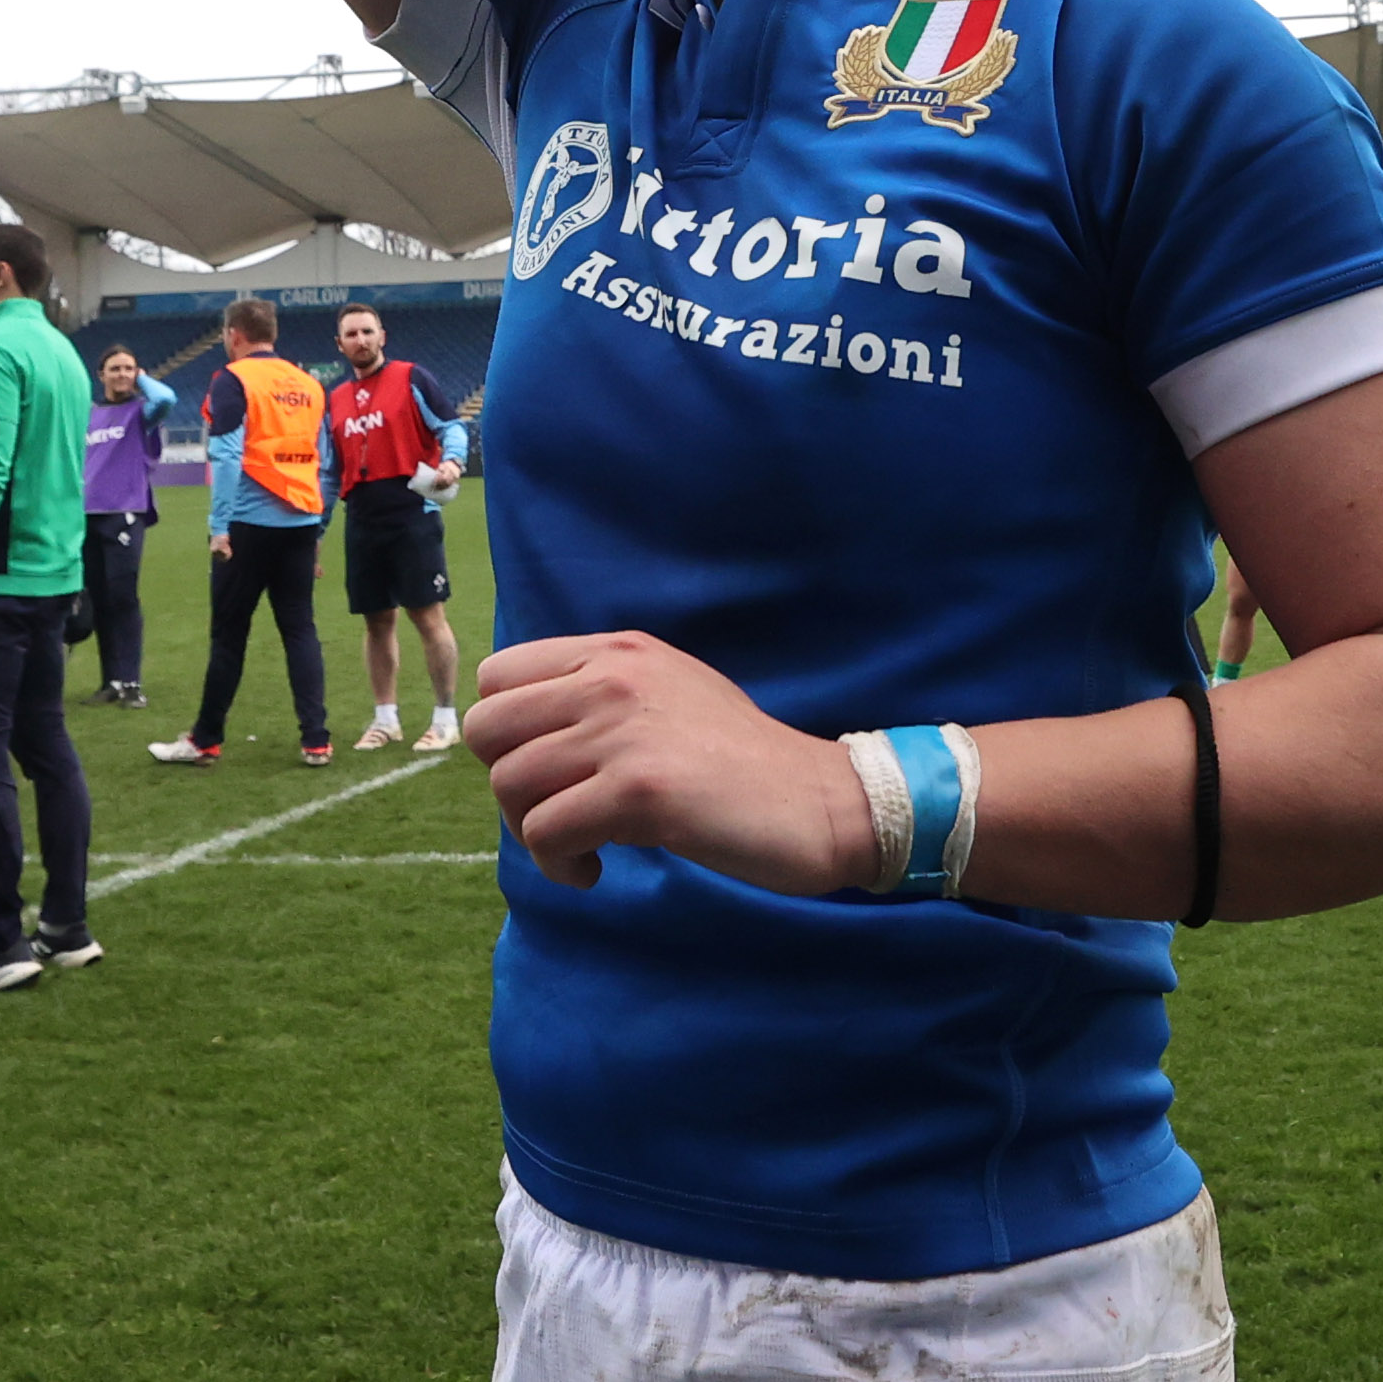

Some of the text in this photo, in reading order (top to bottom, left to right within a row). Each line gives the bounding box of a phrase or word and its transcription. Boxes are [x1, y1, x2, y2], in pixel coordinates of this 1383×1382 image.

[876, 89, 945, 106] ITALIA
[280, 286, 350, 307] CARLOW
[344, 410, 383, 437] AON
